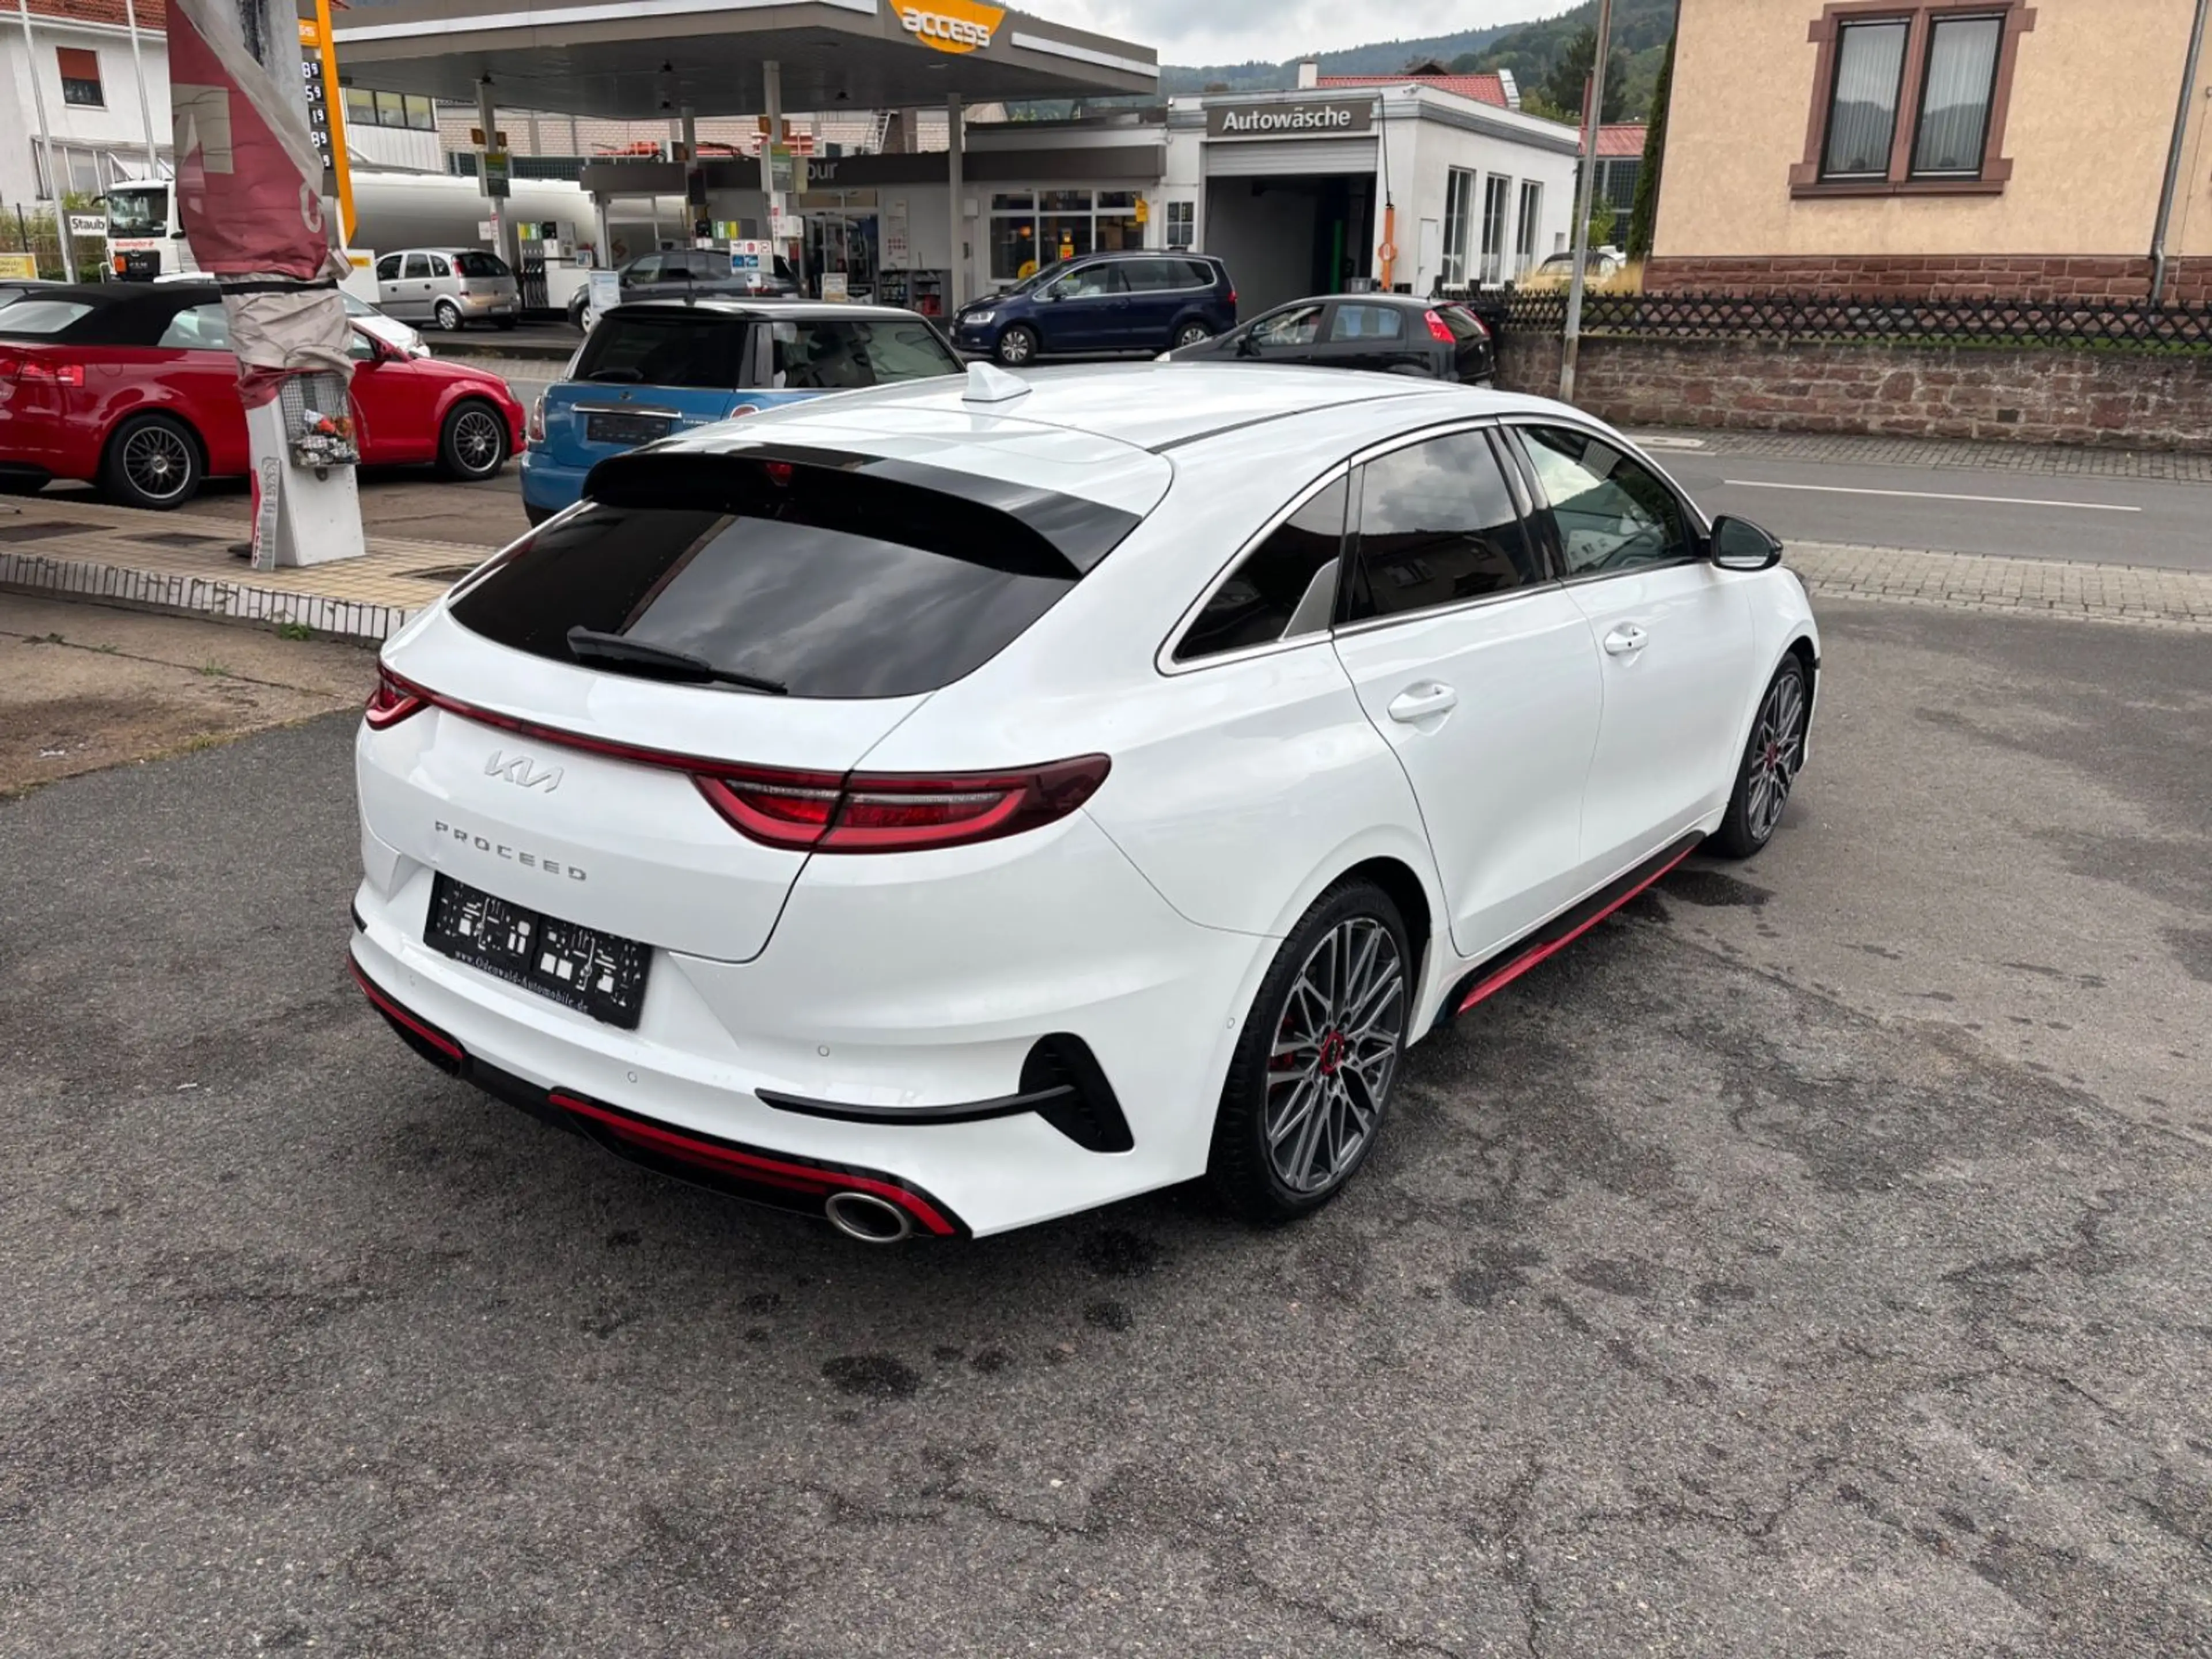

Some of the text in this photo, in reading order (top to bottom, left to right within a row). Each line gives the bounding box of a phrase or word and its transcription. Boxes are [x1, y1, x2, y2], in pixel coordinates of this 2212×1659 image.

[902, 6, 991, 48] access
[1222, 105, 1351, 131] Autowäsche
[484, 749, 565, 793] KIA
[435, 820, 587, 881] PROCEED
